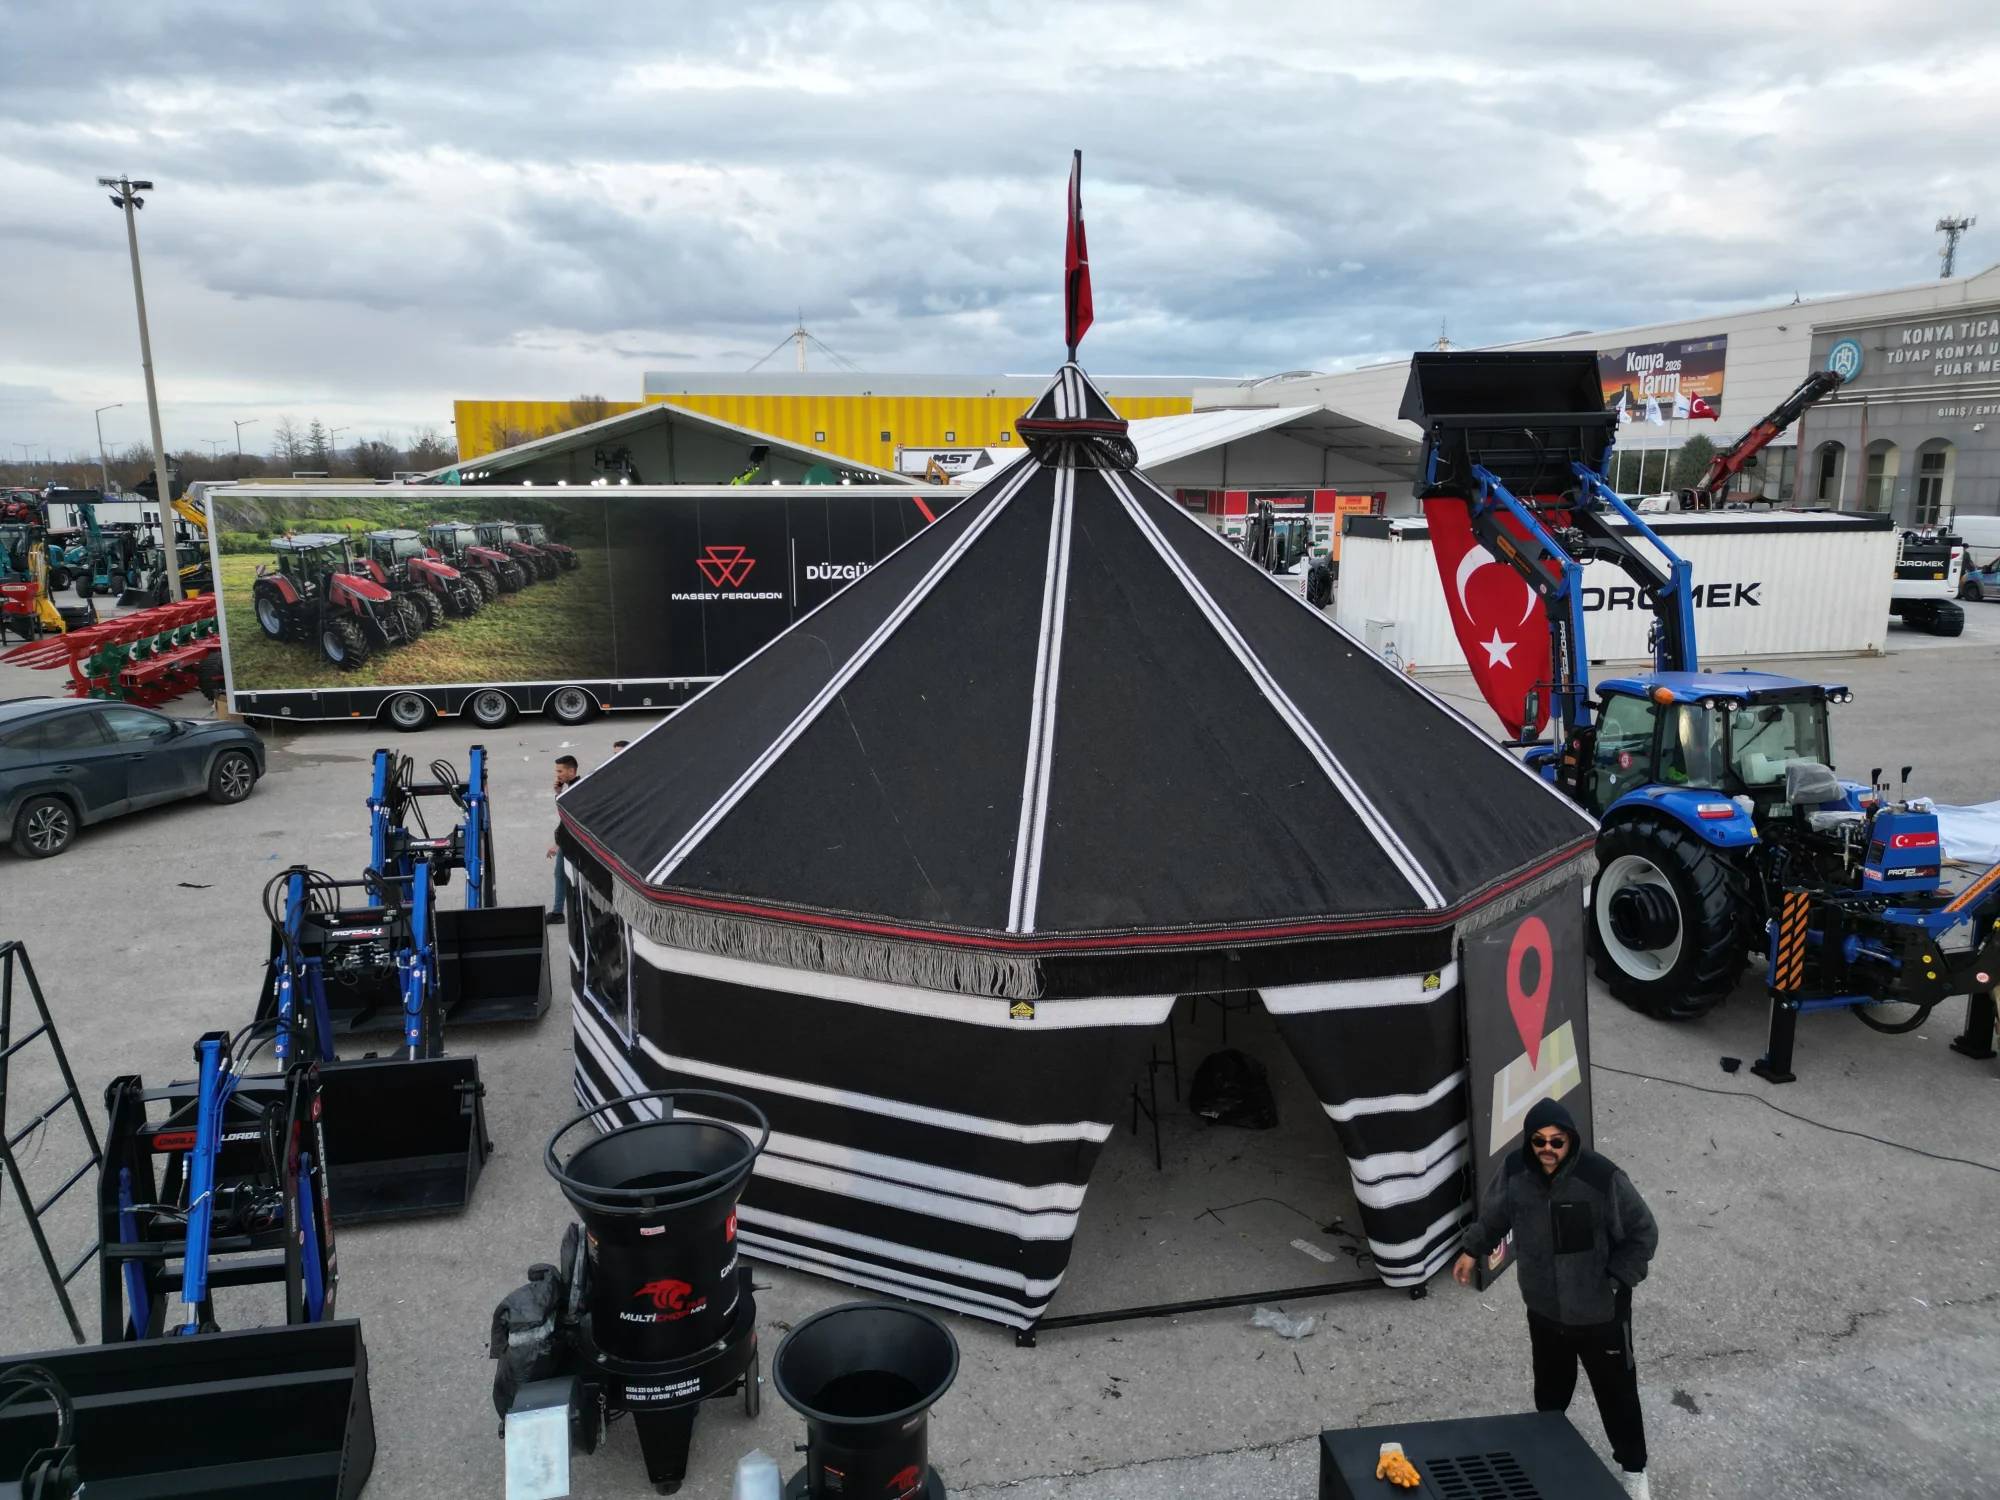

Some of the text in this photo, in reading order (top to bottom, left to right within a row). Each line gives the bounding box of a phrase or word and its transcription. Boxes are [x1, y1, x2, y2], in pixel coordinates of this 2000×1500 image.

[1902, 325, 1954, 344] KONYA
[1626, 352, 1682, 373] Konya 2026
[1888, 349, 1931, 364] TÜYAP
[1935, 343, 1983, 360] KONYA
[1934, 362, 1973, 376] FUAR
[1637, 370, 1680, 395] Tarım
[932, 454, 972, 464] MST
[806, 562, 874, 580] DÜZGÜ
[671, 592, 783, 601] MASSEY FERGUSON
[221, 1131, 268, 1141] LOADE
